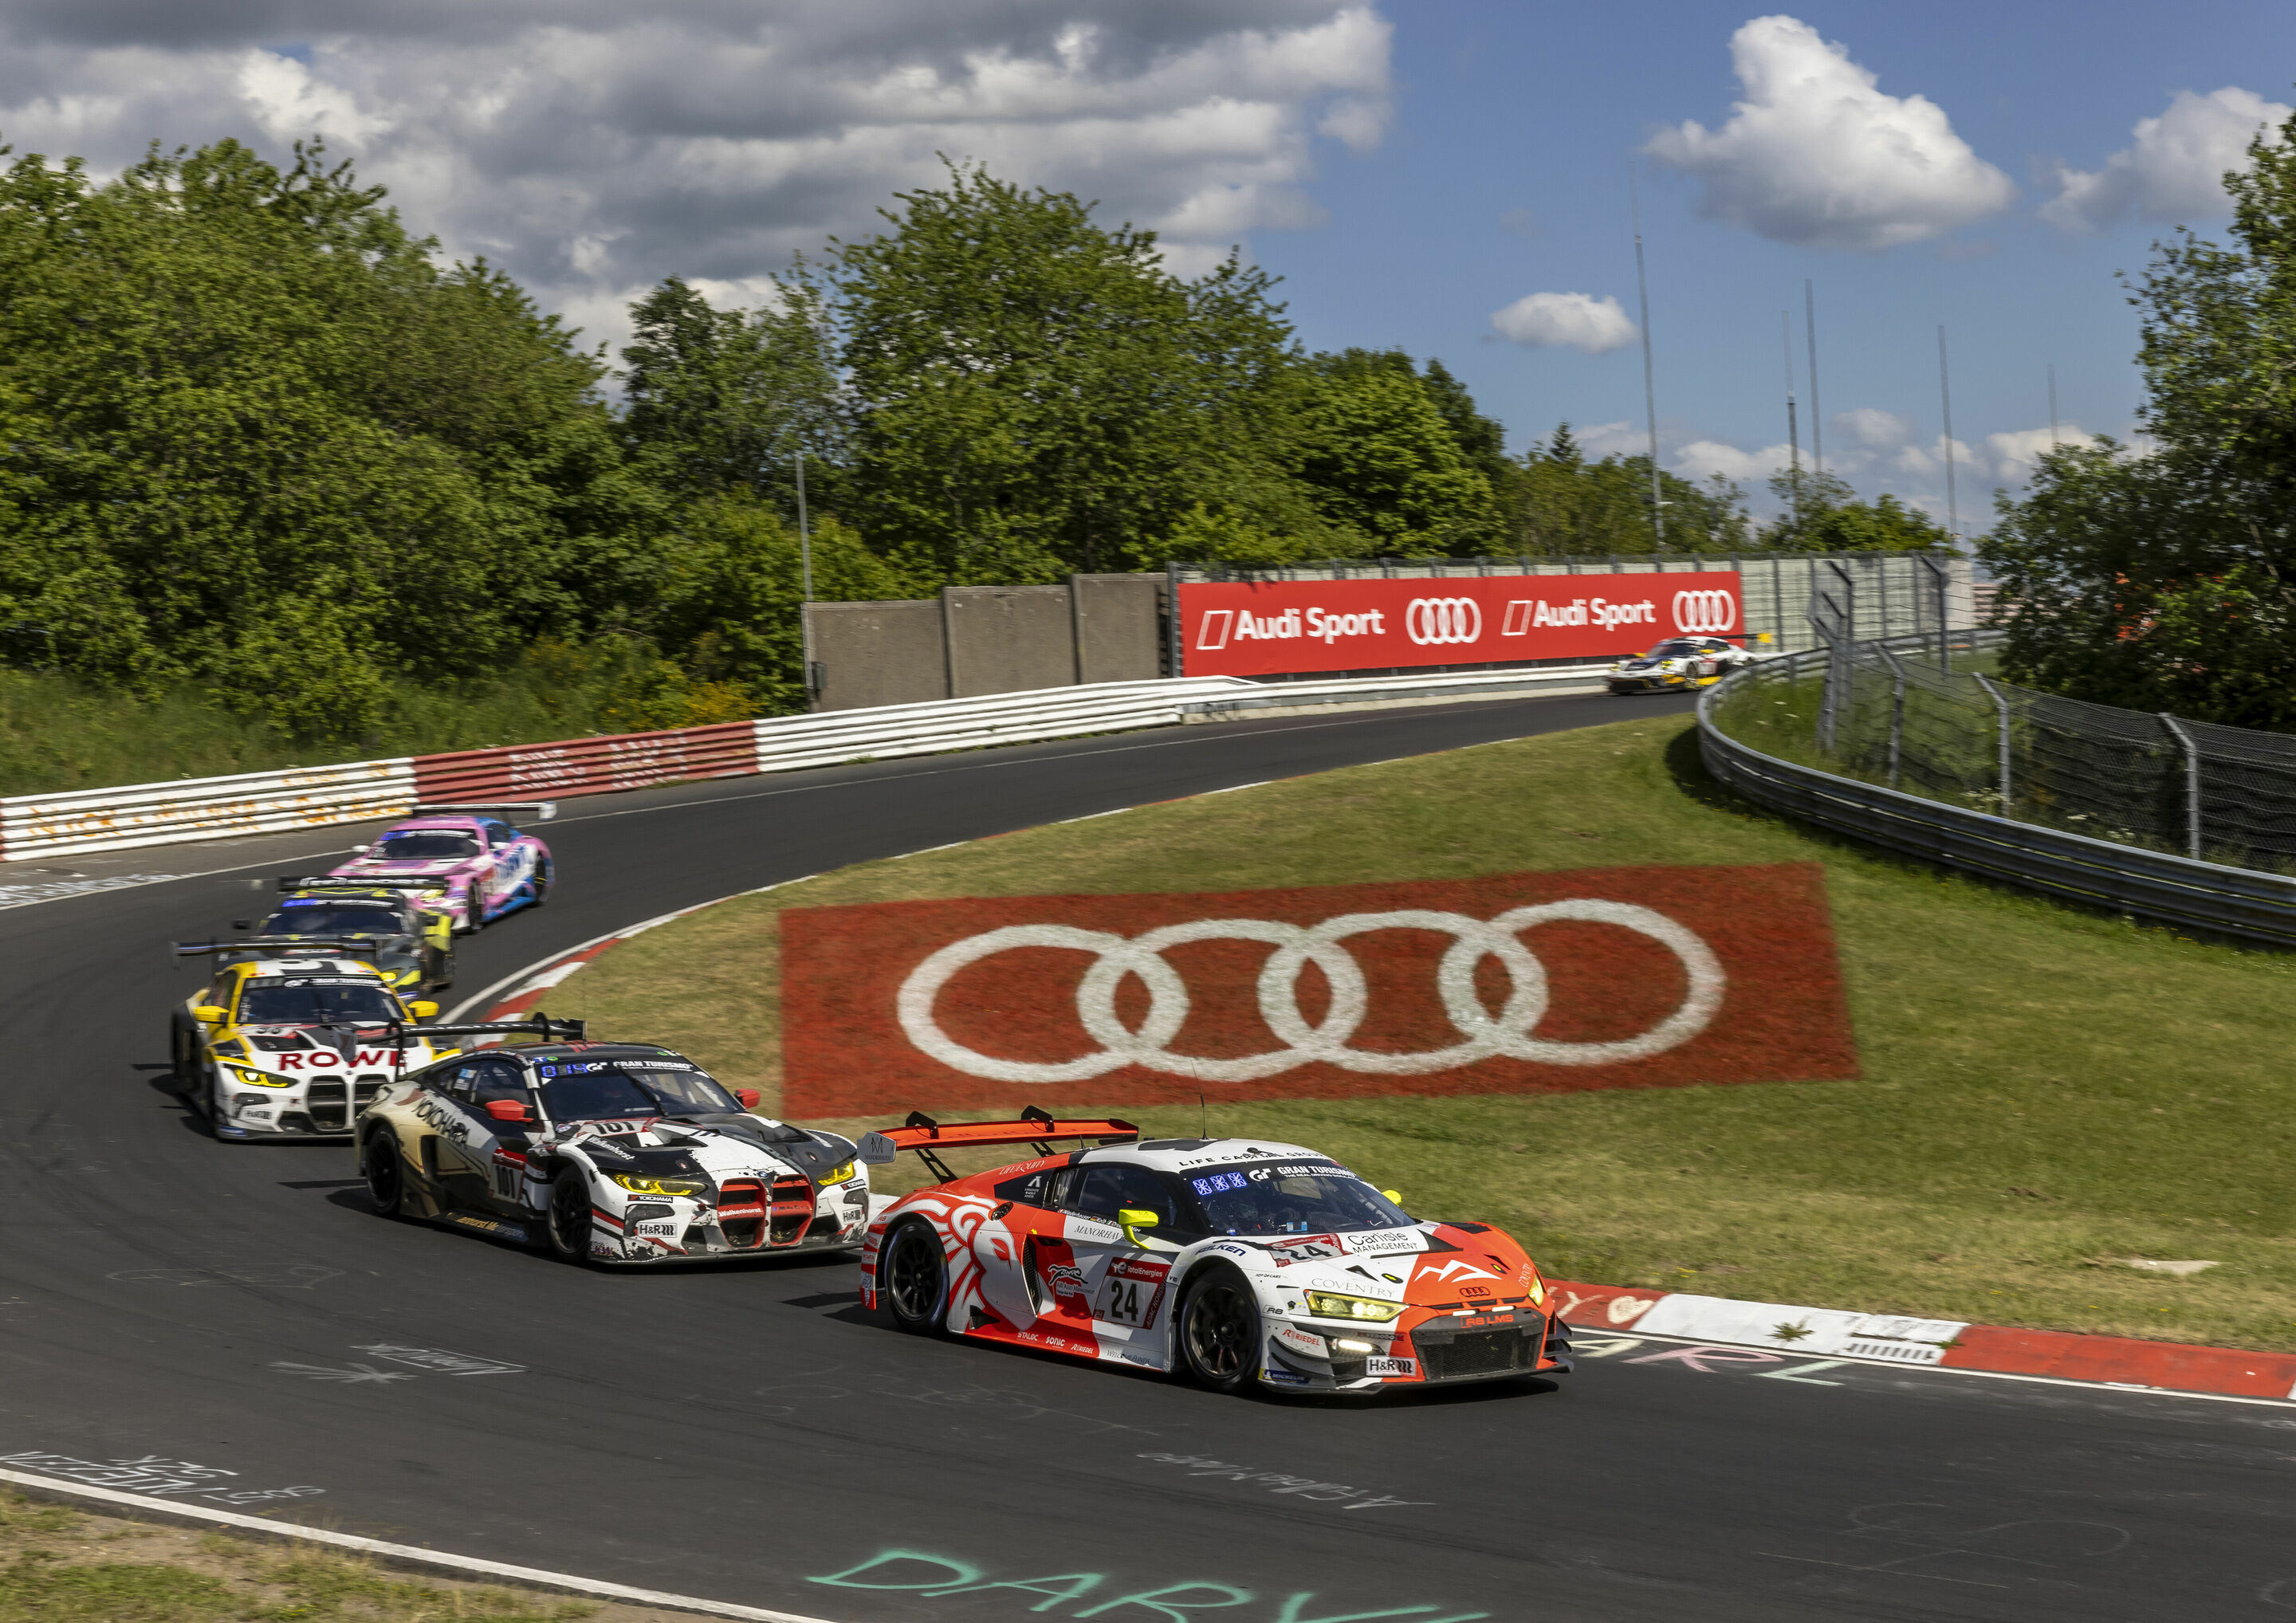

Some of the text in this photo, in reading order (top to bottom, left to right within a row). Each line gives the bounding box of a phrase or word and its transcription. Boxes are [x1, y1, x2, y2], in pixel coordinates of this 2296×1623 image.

[1532, 598, 1657, 631] Audi Sport
[1234, 607, 1386, 644] Audi Sport
[278, 1050, 407, 1071] ROWE
[594, 1122, 635, 1135] 101
[588, 1135, 635, 1160] Walkenhorst
[1179, 1157, 1215, 1166] LIFE
[1277, 1165, 1356, 1178] GRAN TURISMO
[718, 1208, 762, 1216] Walkenhorst
[639, 1224, 660, 1234] H&R
[1347, 1231, 1409, 1246] Carlisle
[1352, 1242, 1417, 1254] MANAGEMENT
[1127, 1265, 1162, 1278] TotalEnergies
[1311, 1278, 1395, 1297] COVENTRY
[1111, 1280, 1138, 1322] 24
[1465, 1315, 1514, 1326] R8 LMS
[1295, 1333, 1320, 1346] RIEDEL
[1079, 1346, 1093, 1354] RIEDEL
[1370, 1359, 1395, 1372] H&R
